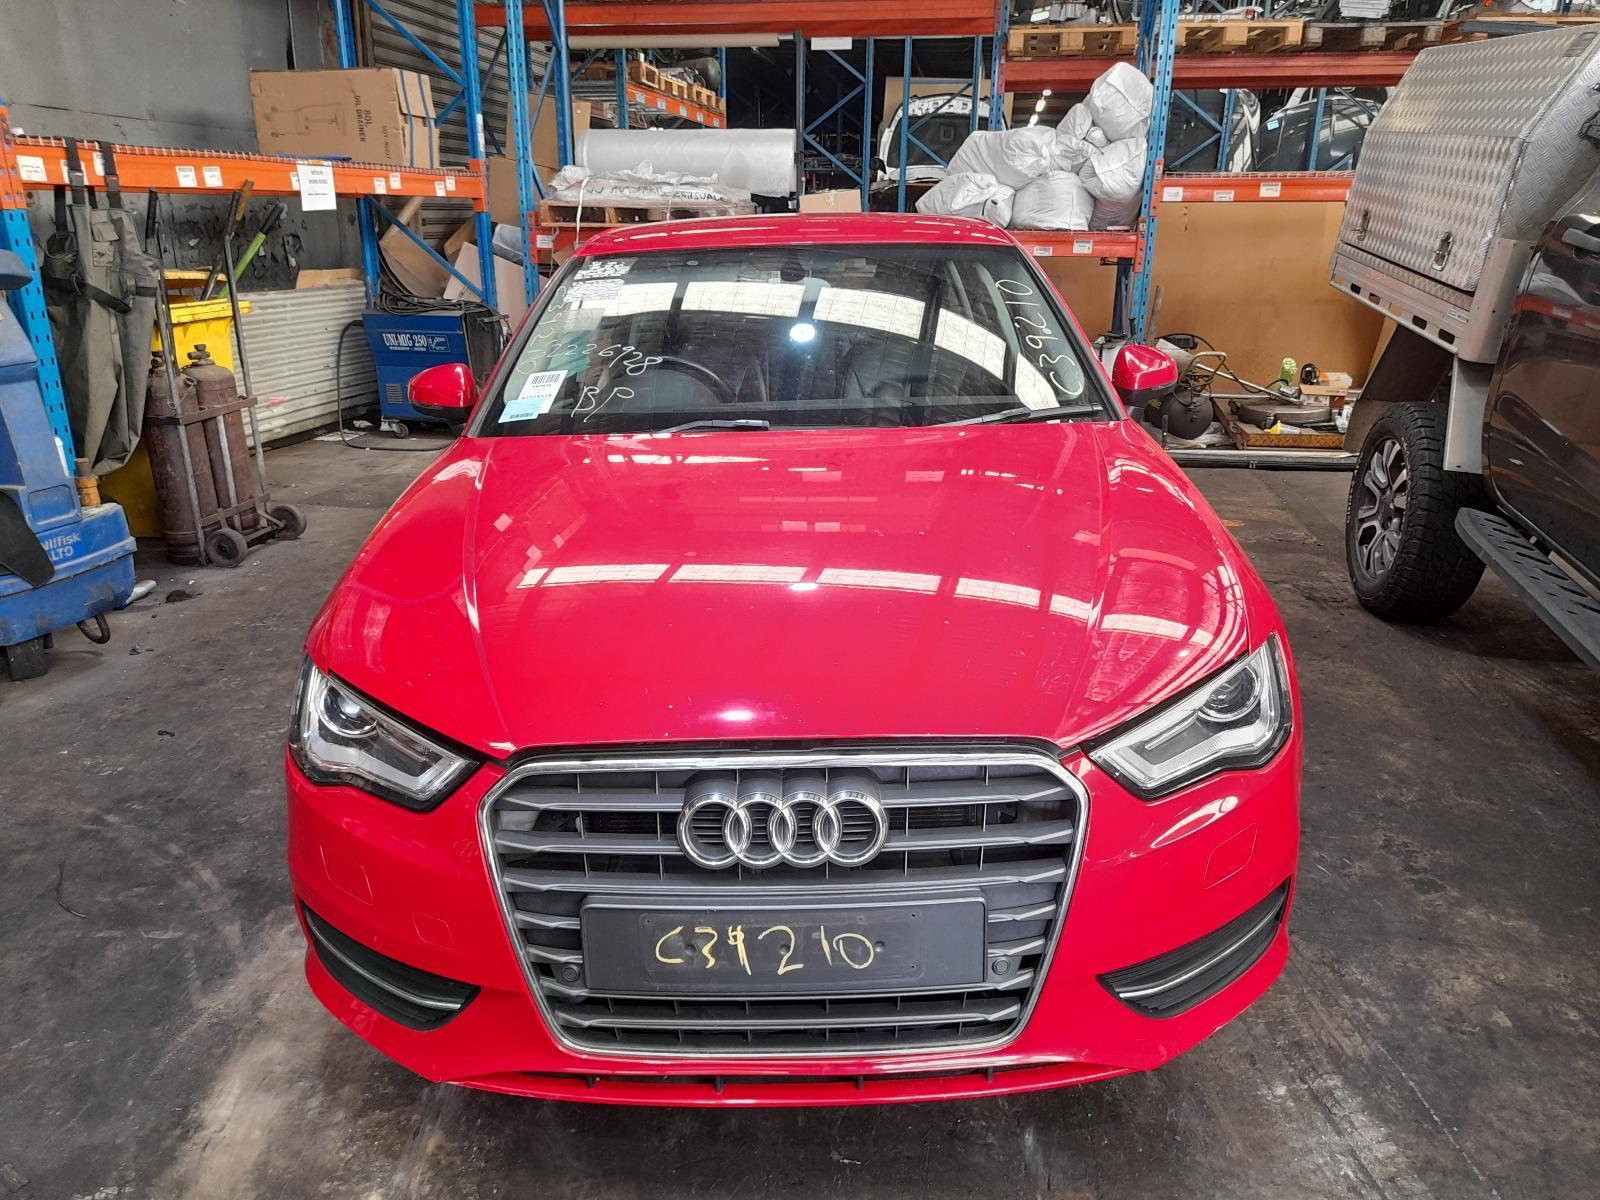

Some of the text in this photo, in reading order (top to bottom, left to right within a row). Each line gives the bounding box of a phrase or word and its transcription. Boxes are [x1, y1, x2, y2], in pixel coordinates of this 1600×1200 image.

[382, 332, 413, 347] UNI-MIG
[412, 333, 428, 347] 250
[995, 279, 1085, 396] C39210
[47, 545, 74, 562] LTO
